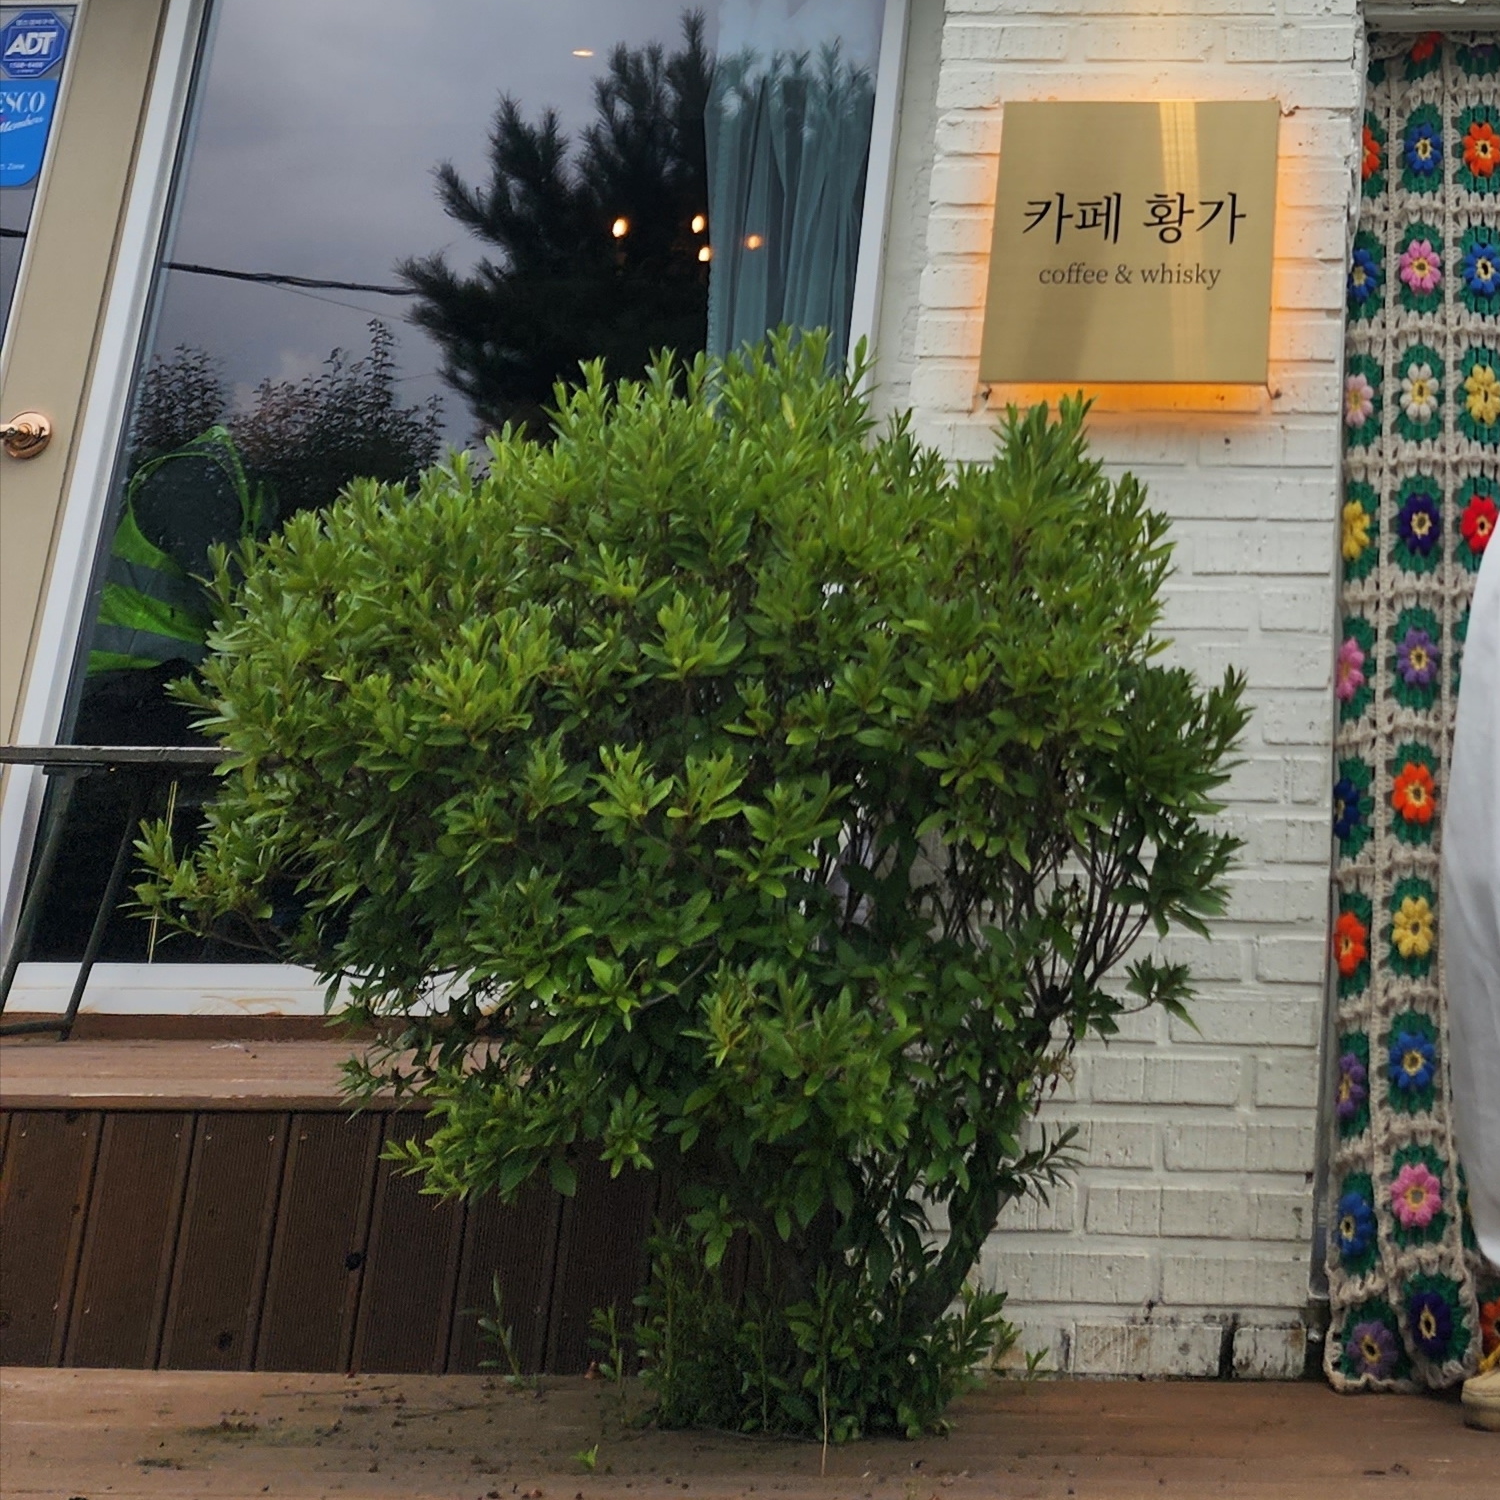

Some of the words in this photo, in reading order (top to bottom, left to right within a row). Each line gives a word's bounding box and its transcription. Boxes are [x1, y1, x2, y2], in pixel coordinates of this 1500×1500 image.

[5, 31, 57, 56] ADT
[0, 91, 46, 113] ESCO
[1022, 192, 1122, 244] 카페
[1143, 192, 1247, 244] 황가
[1039, 262, 1108, 285] coffee
[1115, 263, 1133, 285] &
[1141, 262, 1221, 290] whisky
